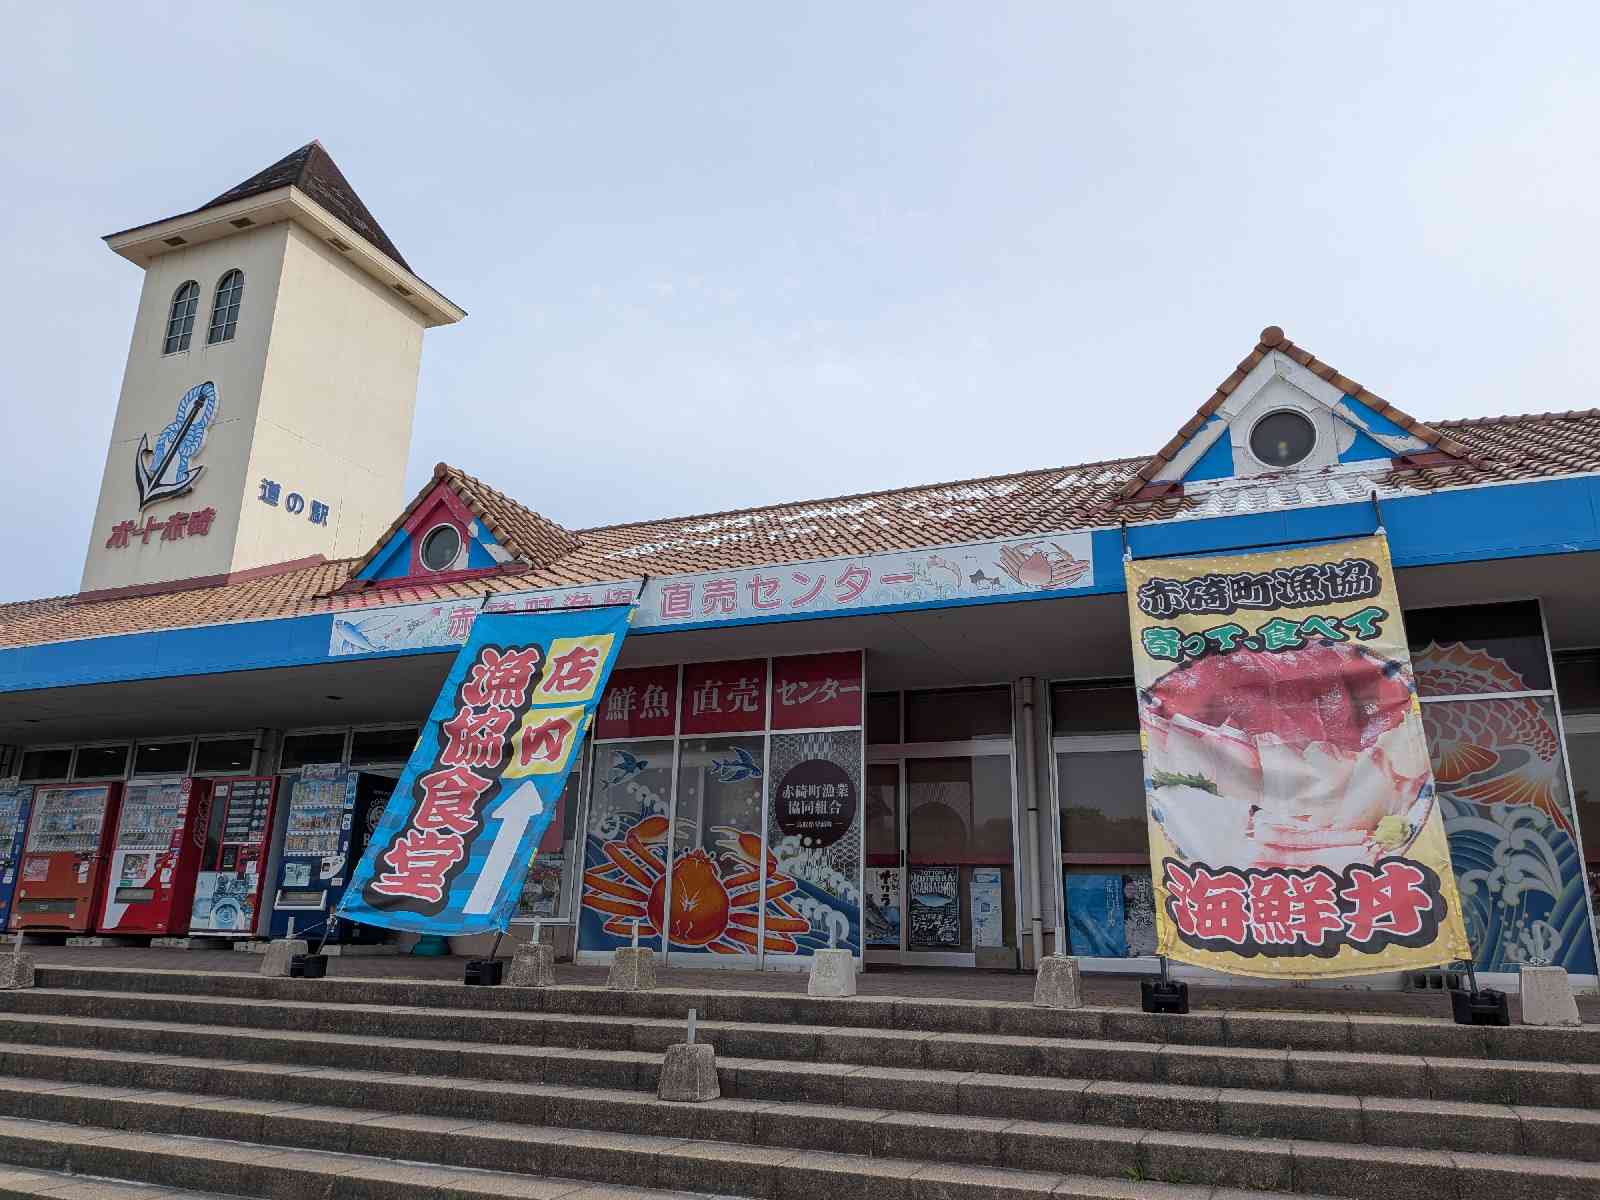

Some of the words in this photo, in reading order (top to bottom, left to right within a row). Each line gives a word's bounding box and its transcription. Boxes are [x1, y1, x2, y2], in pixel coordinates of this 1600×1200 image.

[105, 506, 217, 549] ポート赤碕
[258, 478, 330, 527] 道の駅
[1138, 560, 1376, 616] 赤碕町漁協
[1142, 608, 1384, 658] 寄って、食べて
[521, 646, 600, 766] 店内
[776, 677, 862, 707] センター
[371, 648, 540, 904] 漁協食堂
[1165, 862, 1433, 946] 海鮮丼
